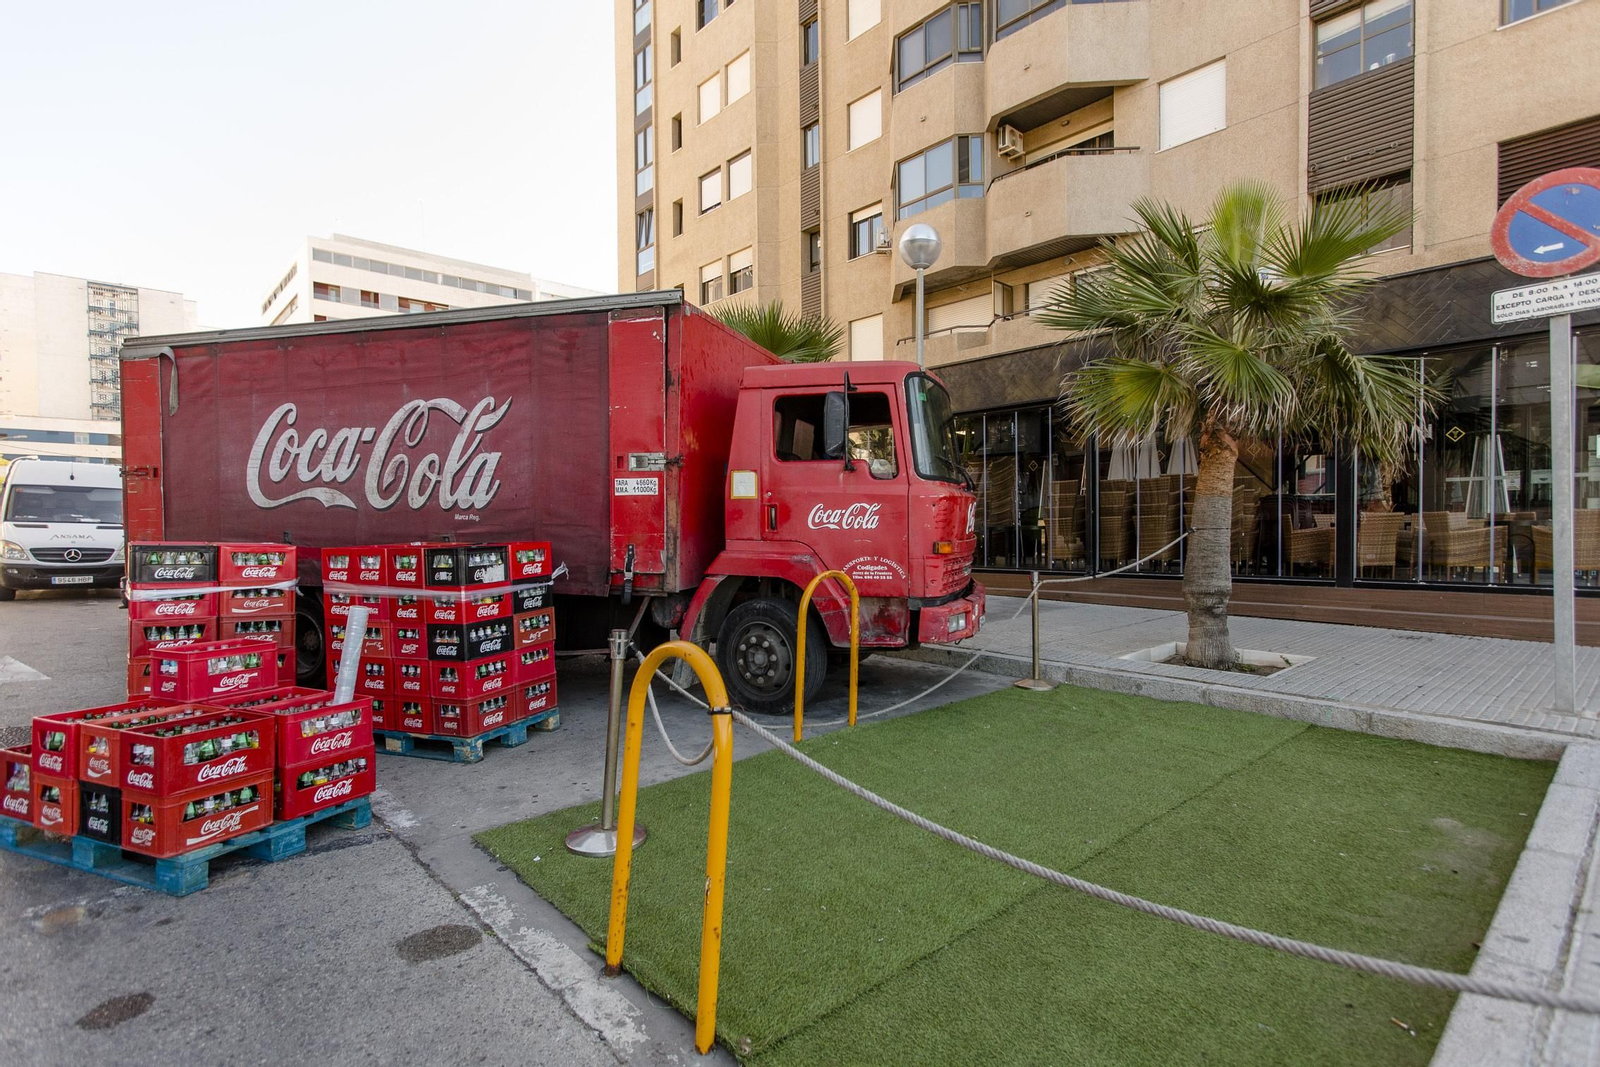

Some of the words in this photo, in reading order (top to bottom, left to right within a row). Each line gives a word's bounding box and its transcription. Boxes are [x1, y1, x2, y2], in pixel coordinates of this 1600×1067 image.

[1496, 299, 1532, 311] EXCEPTO
[1535, 294, 1565, 304] CARGA
[1532, 302, 1574, 313] LABORABLES
[246, 396, 512, 510] Coca-Cola
[469, 513, 480, 522] Reg.
[807, 502, 882, 530] Coca-Cola
[50, 533, 96, 541] ANSAMA
[523, 563, 542, 575] Coca-Cola
[841, 556, 871, 574] ANSPORTE
[856, 564, 888, 572] Codigades
[154, 566, 196, 579] Coca-Cola
[242, 566, 278, 578] Coca-Cola
[329, 571, 348, 581] Coca-Cola
[360, 571, 380, 581] Coca-Cola
[395, 571, 416, 582] Coca-Cola
[155, 602, 197, 615] Coca-Cola
[243, 599, 270, 608] Coca-Cola
[523, 596, 543, 609] Coca-Cola
[331, 605, 349, 615] Coca-Col
[396, 608, 418, 618] Coca-Cola
[434, 610, 456, 621] Coca-Cola
[477, 604, 499, 617] Coca-Cola
[436, 645, 457, 656] Coca-Cola
[480, 639, 502, 653] Coca-Cola
[220, 673, 249, 687] Coca-Cola
[365, 679, 385, 689] Coca-Cola
[403, 681, 420, 690] Coca-Cola
[482, 677, 502, 692] Coca-Cola
[529, 697, 546, 710] Coca-Cola
[404, 717, 423, 728] Coca-Cola
[483, 711, 503, 727] Coca-Cola
[311, 730, 353, 755] Coca-Cola
[39, 753, 63, 773] Coca-Cola
[89, 757, 109, 771] Coca-Cola
[197, 755, 248, 782] Coca-Cola
[127, 769, 154, 789] Coca-Cola
[313, 778, 353, 803] Coca-Cola
[3, 794, 30, 814] Coca-Cola
[42, 805, 62, 819] Coca-Cola
[88, 816, 109, 834] Coca-Cola
[201, 811, 242, 835] Coca-Cola
